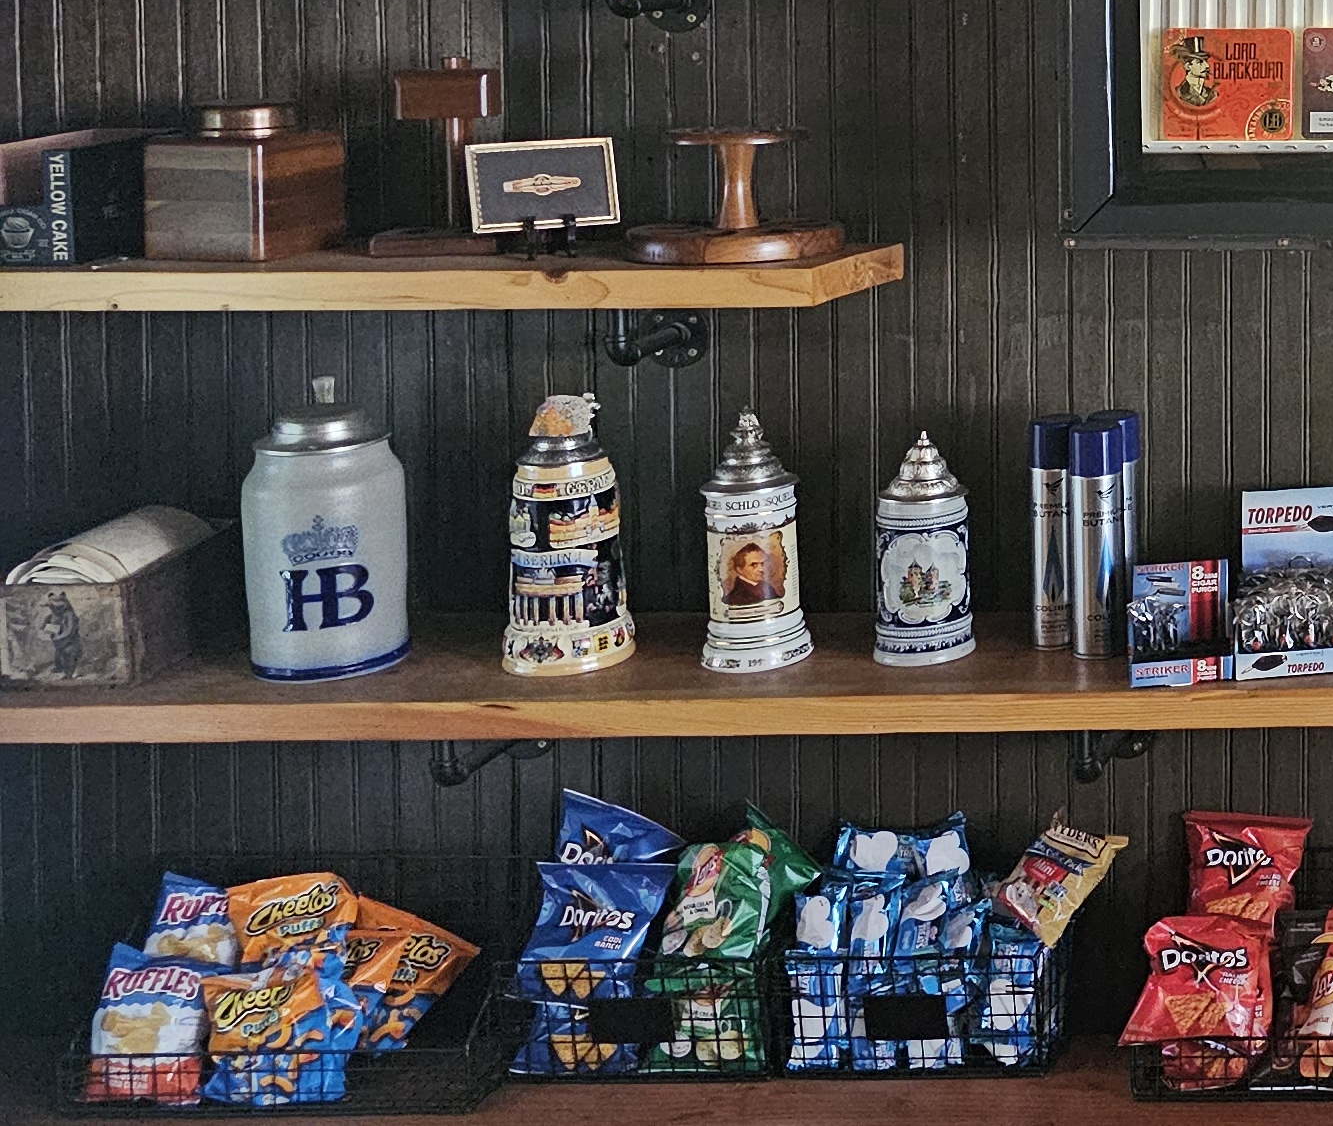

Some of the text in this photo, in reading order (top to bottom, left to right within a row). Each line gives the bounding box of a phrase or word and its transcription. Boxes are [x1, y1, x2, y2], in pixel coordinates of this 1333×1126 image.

[1225, 43, 1257, 61] LORD
[48, 154, 68, 261] YELLOW CAKE
[1248, 504, 1313, 525] TORPEDO
[523, 552, 572, 568] BERLIN
[1135, 664, 1188, 676] STRIKER
[247, 884, 339, 935] Cheetos
[560, 906, 635, 929] Doritos
[103, 967, 200, 999] RUFFLES
